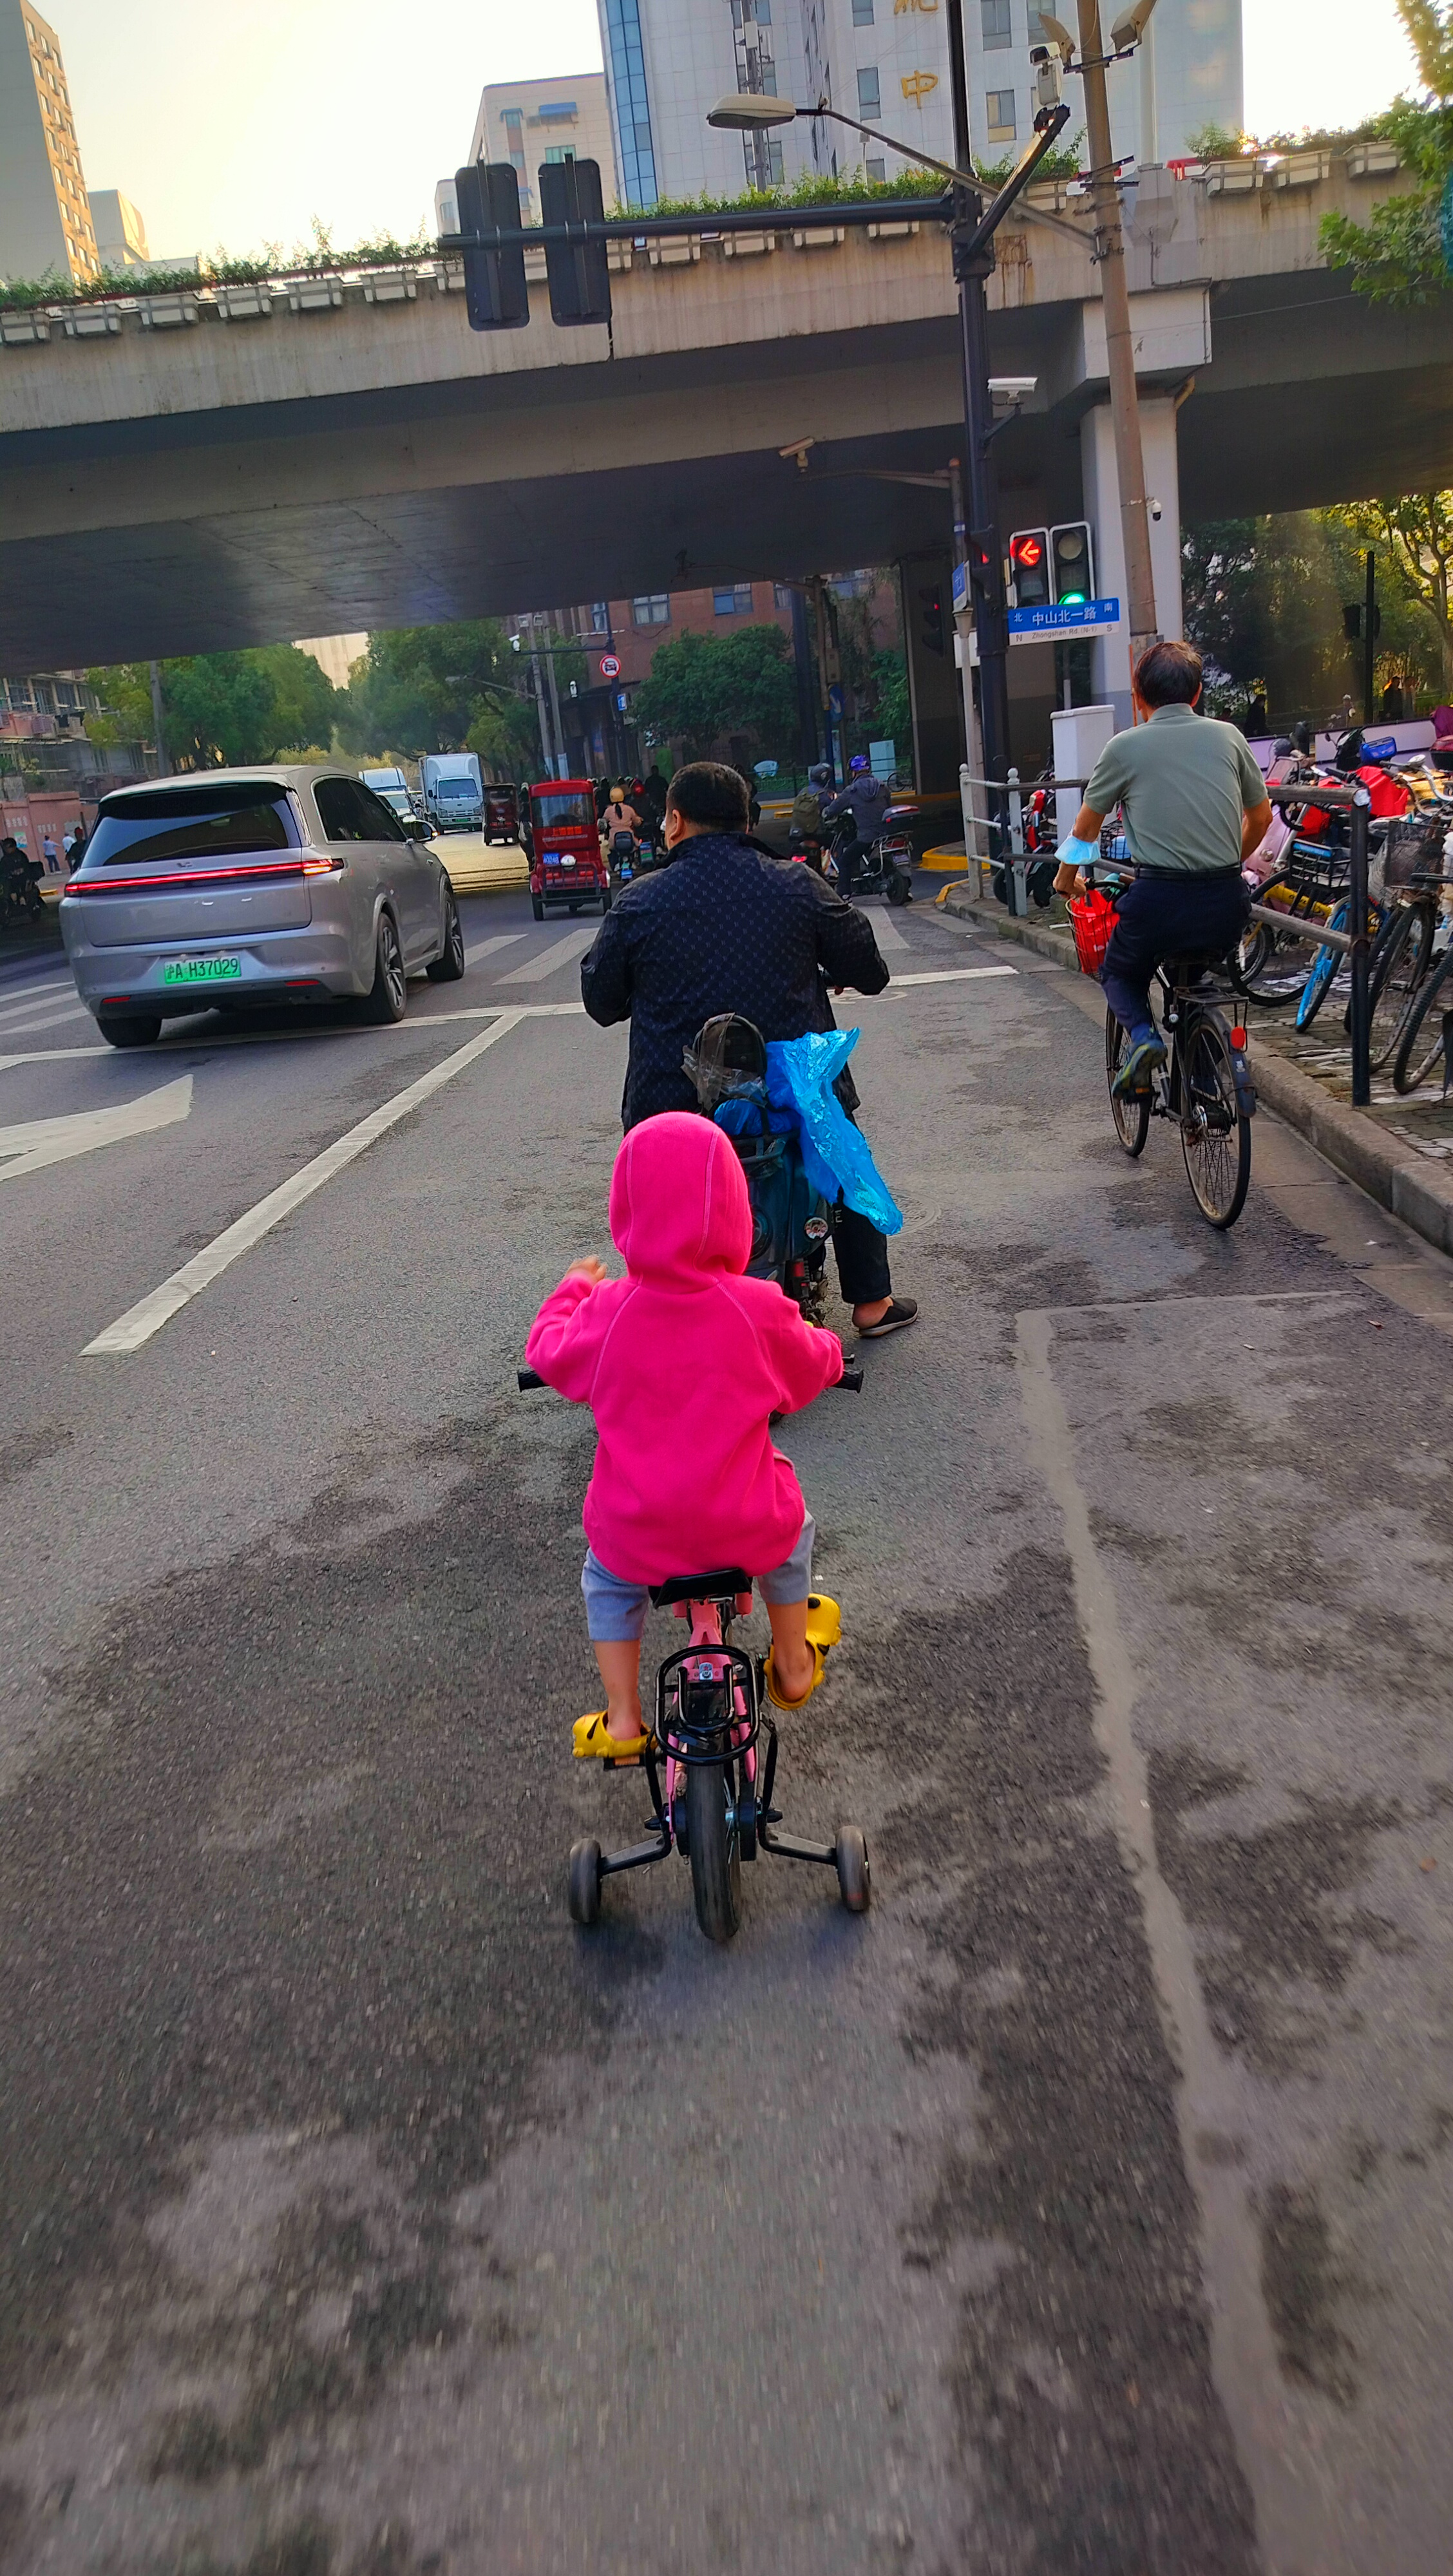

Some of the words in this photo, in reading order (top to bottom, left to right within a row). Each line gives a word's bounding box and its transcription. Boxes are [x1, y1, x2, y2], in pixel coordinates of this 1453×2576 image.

[901, 70, 938, 109] 中
[1014, 612, 1023, 622] 北
[1032, 606, 1097, 627] 中山北一路
[1104, 602, 1113, 612] 南
[1032, 629, 1067, 639] Zhongshan
